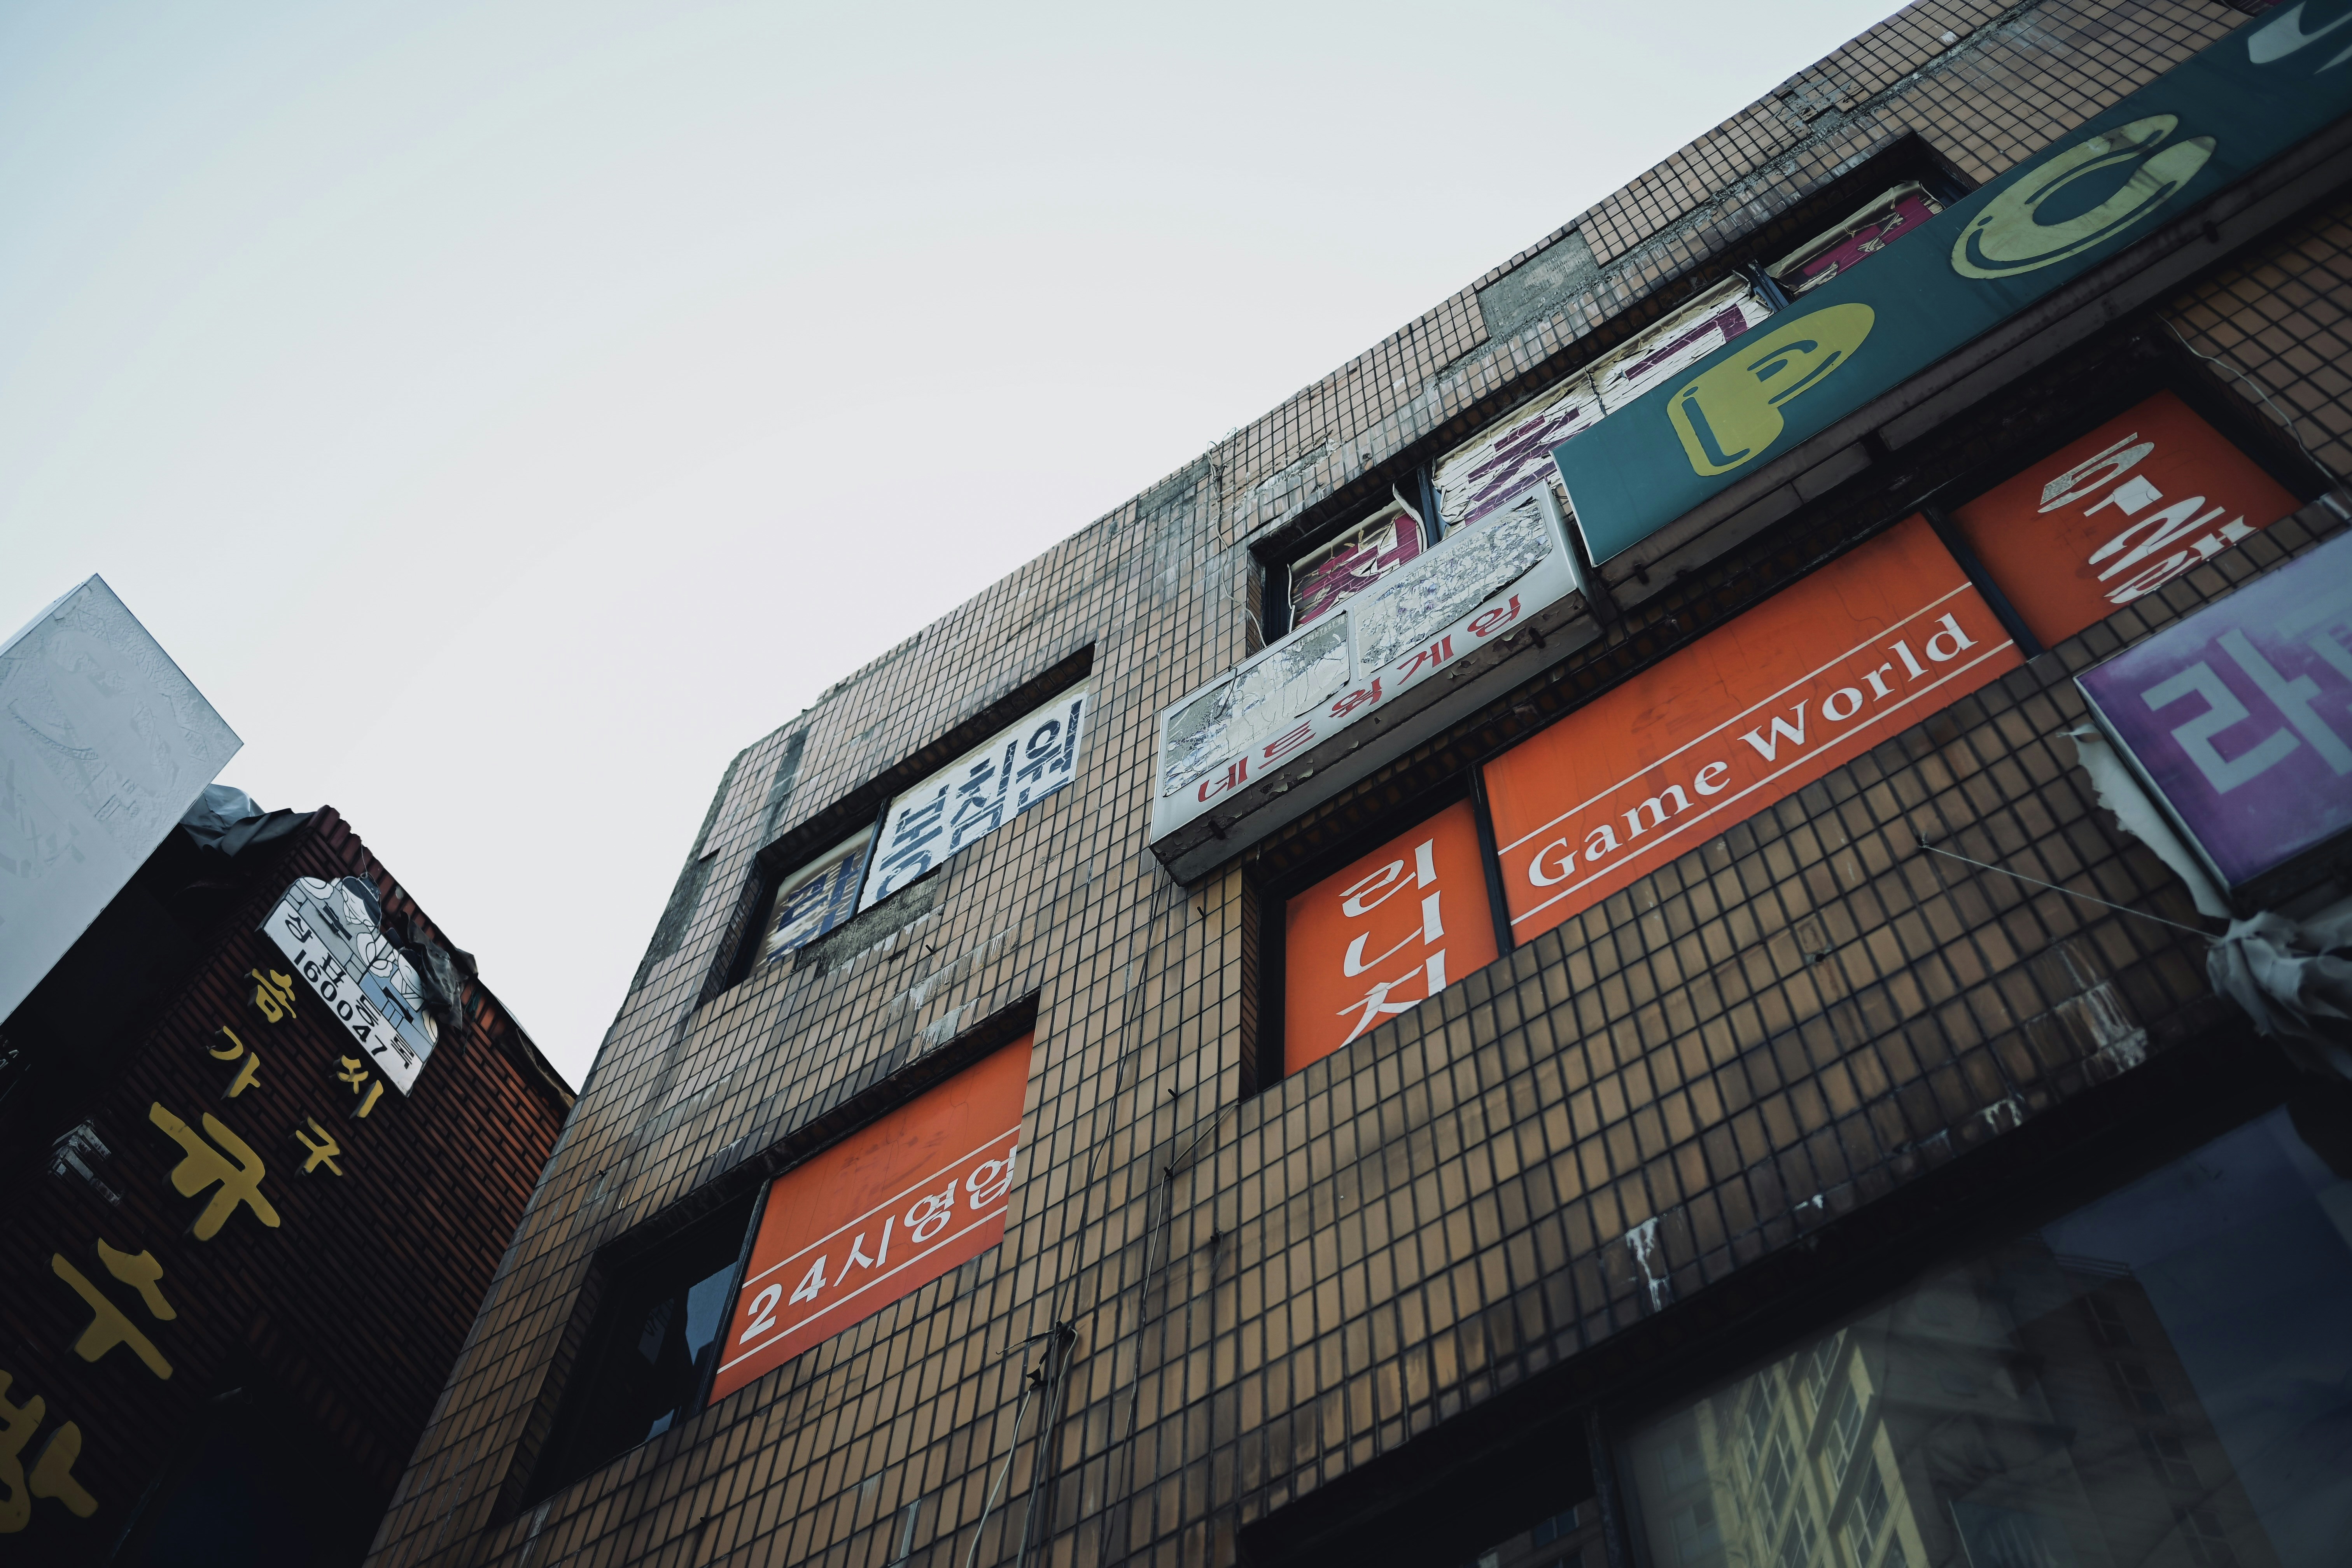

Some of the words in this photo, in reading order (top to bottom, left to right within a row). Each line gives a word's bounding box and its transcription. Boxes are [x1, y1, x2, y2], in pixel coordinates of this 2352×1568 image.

[1198, 593, 1521, 803] 네트웍게임
[1527, 761, 1731, 887] Game
[1737, 612, 1979, 761] World
[2140, 597, 2352, 795] 라
[285, 912, 415, 1069] 상표등록
[293, 949, 388, 1057] 160047
[1335, 838, 1446, 1049] 리니지
[739, 1143, 1018, 1345] 24시영업
